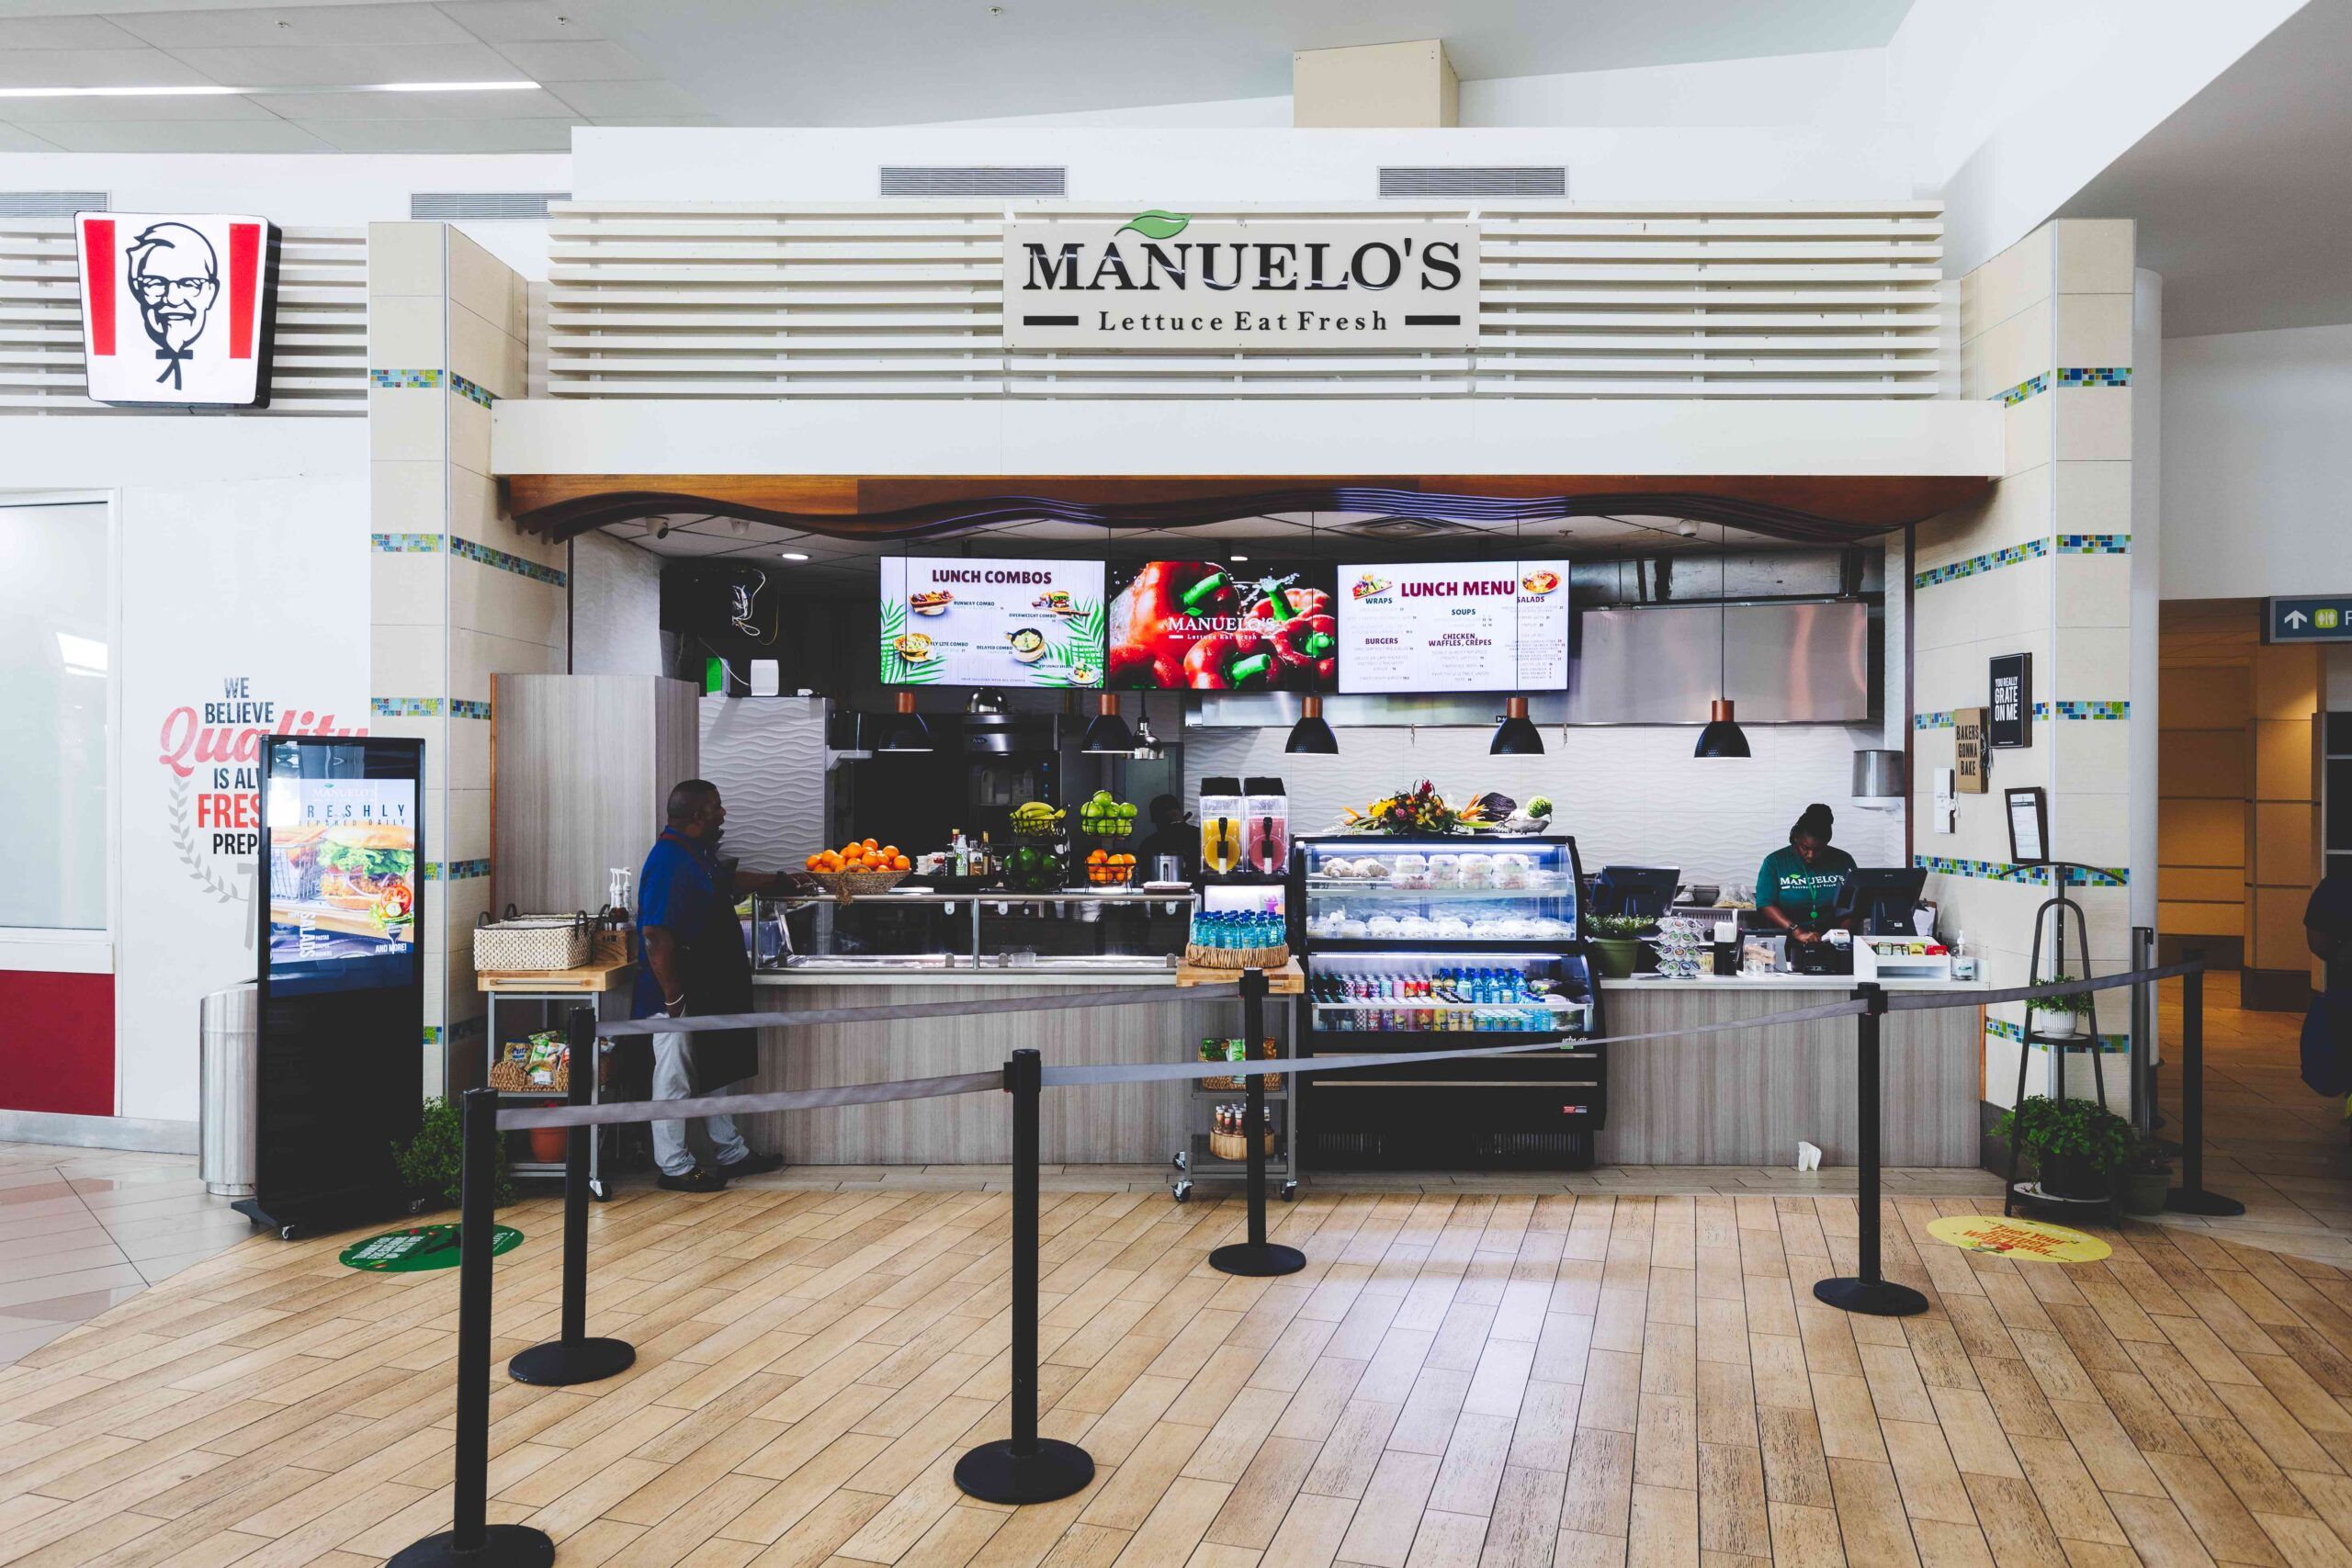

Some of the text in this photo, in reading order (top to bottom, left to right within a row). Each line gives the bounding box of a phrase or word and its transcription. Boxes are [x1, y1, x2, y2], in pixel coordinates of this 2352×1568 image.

[1023, 238, 1460, 290] MANUELO'S
[1098, 310, 1387, 331] Lettuce Eat Fresh
[932, 570, 1052, 584] LUNCH COMBOS
[1401, 581, 1515, 597] LUNCH MENU
[1168, 616, 1276, 631] MANUELO'S
[223, 677, 250, 699] WE
[1995, 676, 2018, 687] YOU REALLY
[1995, 685, 2018, 705] GRATE
[205, 702, 275, 724] BELIEVE
[1995, 703, 2018, 722] ON ME
[1956, 725, 1979, 740] BAKERS
[1958, 742, 1978, 758] GONNA
[1960, 760, 1976, 776] BAKE
[213, 768, 230, 789] IS
[307, 804, 406, 818] RESHLY
[368, 818, 406, 827] DAILY
[300, 911, 316, 958] SALADS
[375, 942, 407, 953] AND MORE!
[1984, 1229, 2051, 1247] Journey
[1992, 1224, 2030, 1235] Fuel
[2030, 1233, 2067, 1245] Your
